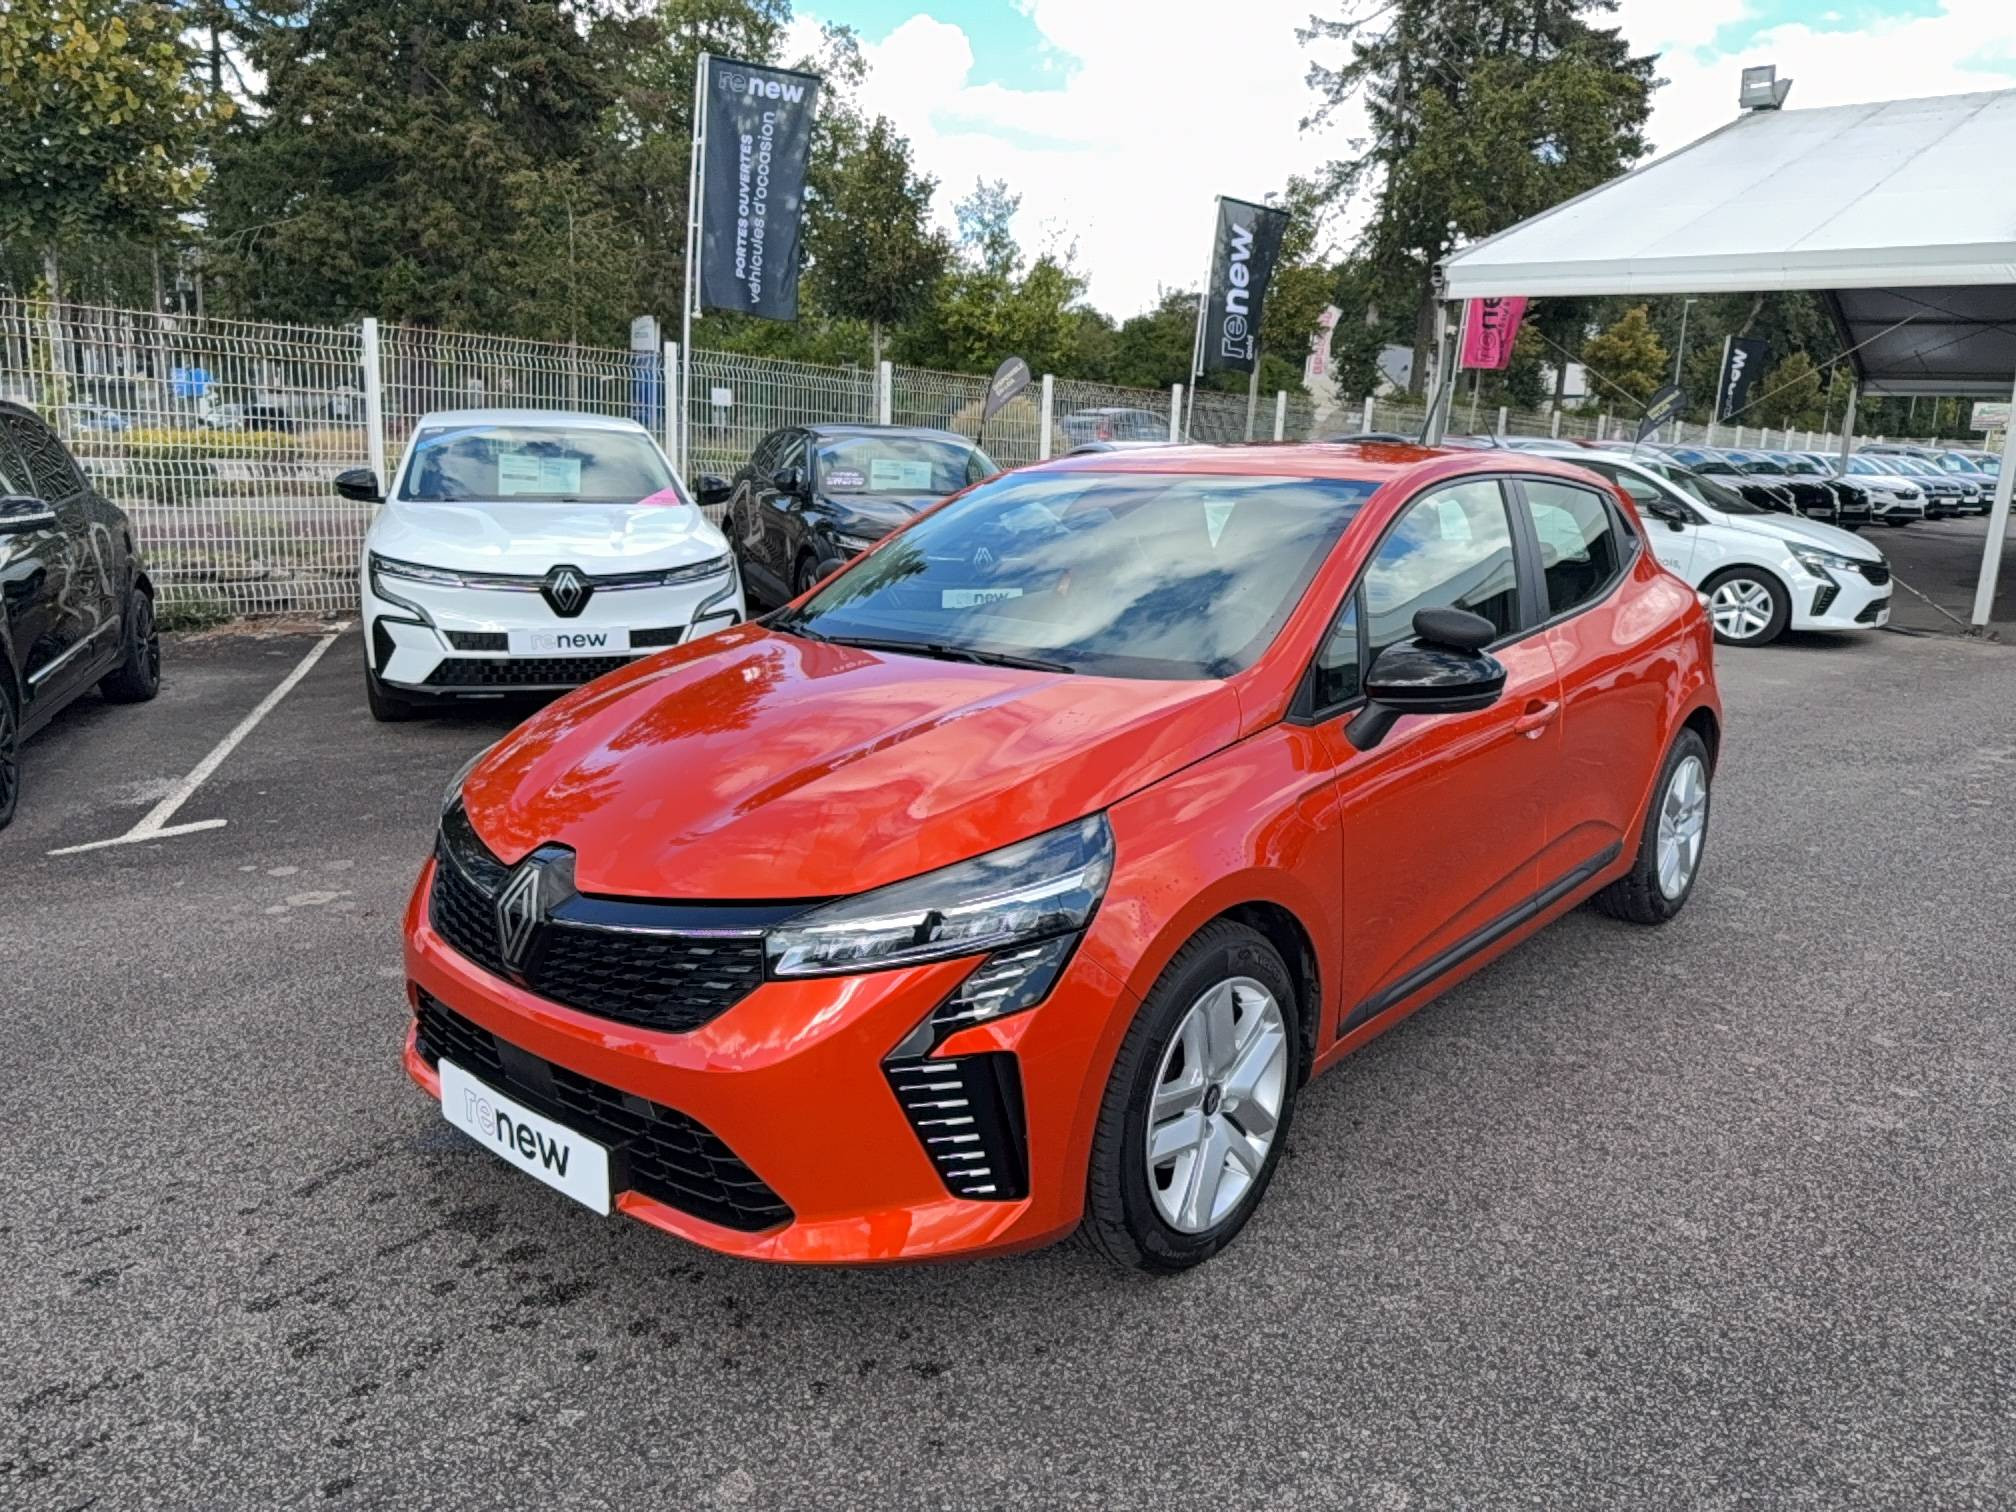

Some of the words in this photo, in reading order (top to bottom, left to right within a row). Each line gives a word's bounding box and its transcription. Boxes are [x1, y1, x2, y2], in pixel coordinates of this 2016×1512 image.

[718, 71, 804, 103] renew
[739, 133, 754, 217] OUVERTES
[752, 111, 776, 215] d'occasion
[735, 218, 750, 279] PORTES
[749, 219, 765, 304] véhicules
[1221, 223, 1254, 359] renew
[1477, 297, 1502, 363] rene
[530, 632, 608, 650] renew
[463, 1087, 570, 1178] renew
